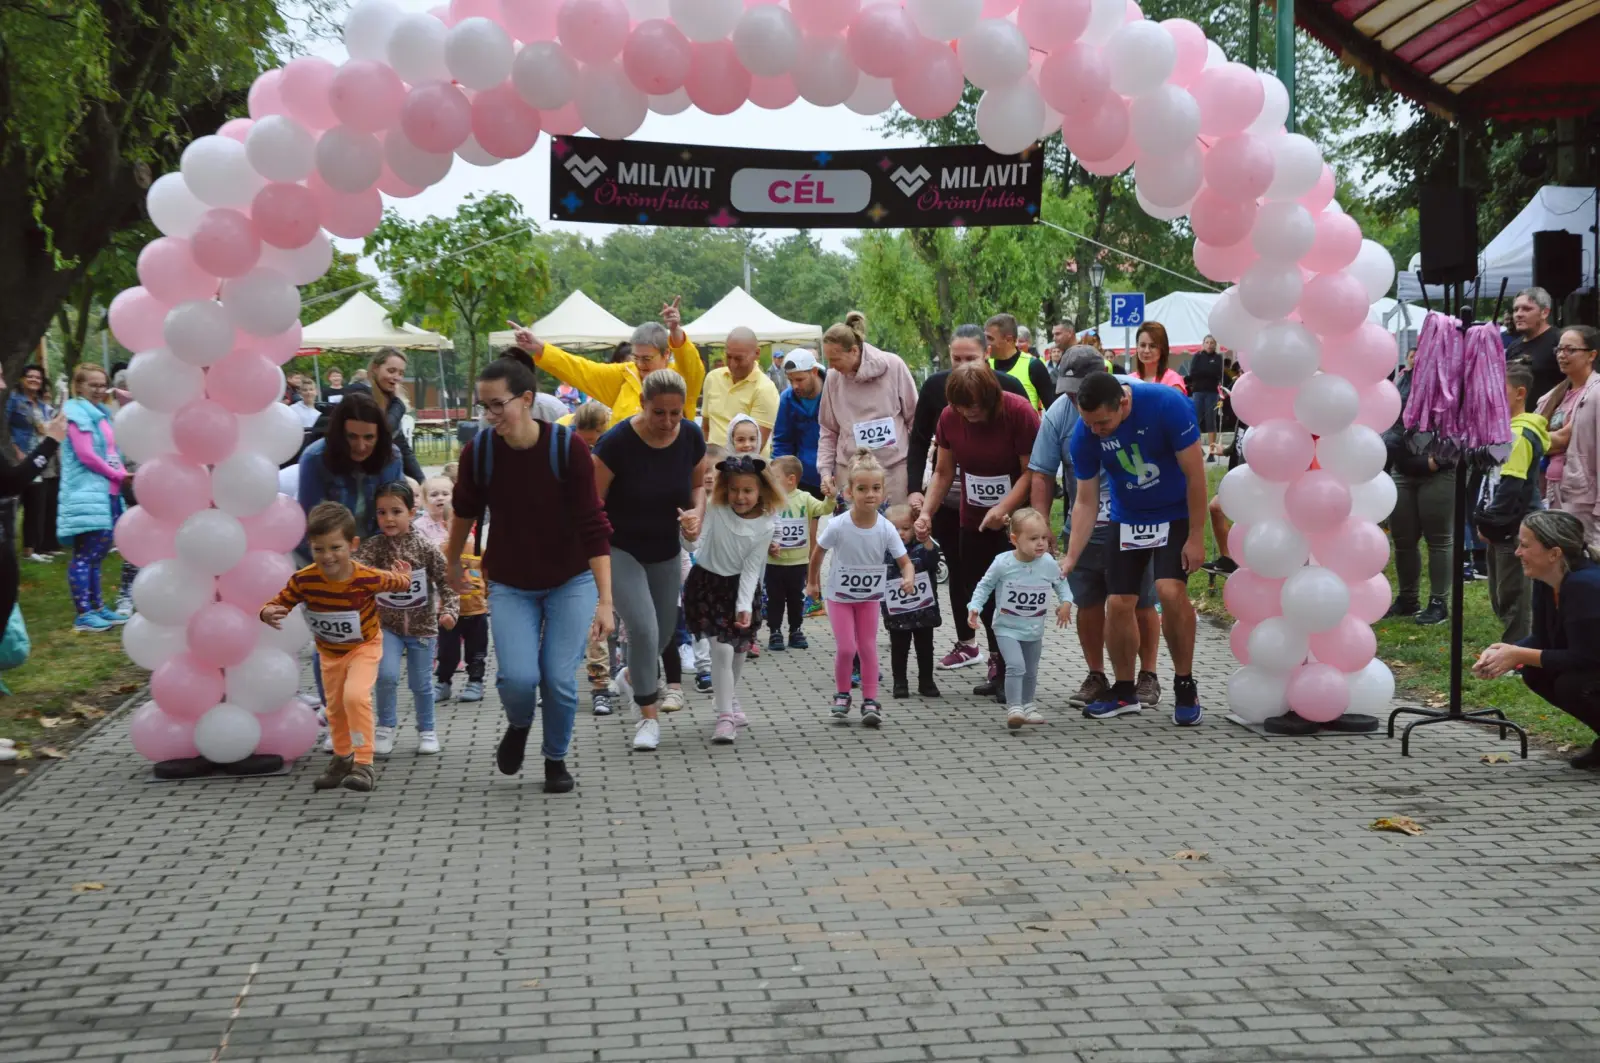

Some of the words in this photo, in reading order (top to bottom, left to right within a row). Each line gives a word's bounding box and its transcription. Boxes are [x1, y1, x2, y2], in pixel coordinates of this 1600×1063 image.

[617, 161, 716, 189] MILAVIT
[940, 162, 1032, 189] MILAVIT
[767, 173, 835, 204] CÉL
[1114, 297, 1127, 314] P
[1113, 314, 1124, 325] 2x
[859, 425, 892, 441] 2024
[1101, 439, 1121, 452] NN
[970, 483, 1006, 496] 1508
[782, 525, 804, 537] 025
[840, 574, 882, 588] 2007
[1007, 590, 1047, 605] 2028
[308, 616, 353, 634] 2018
